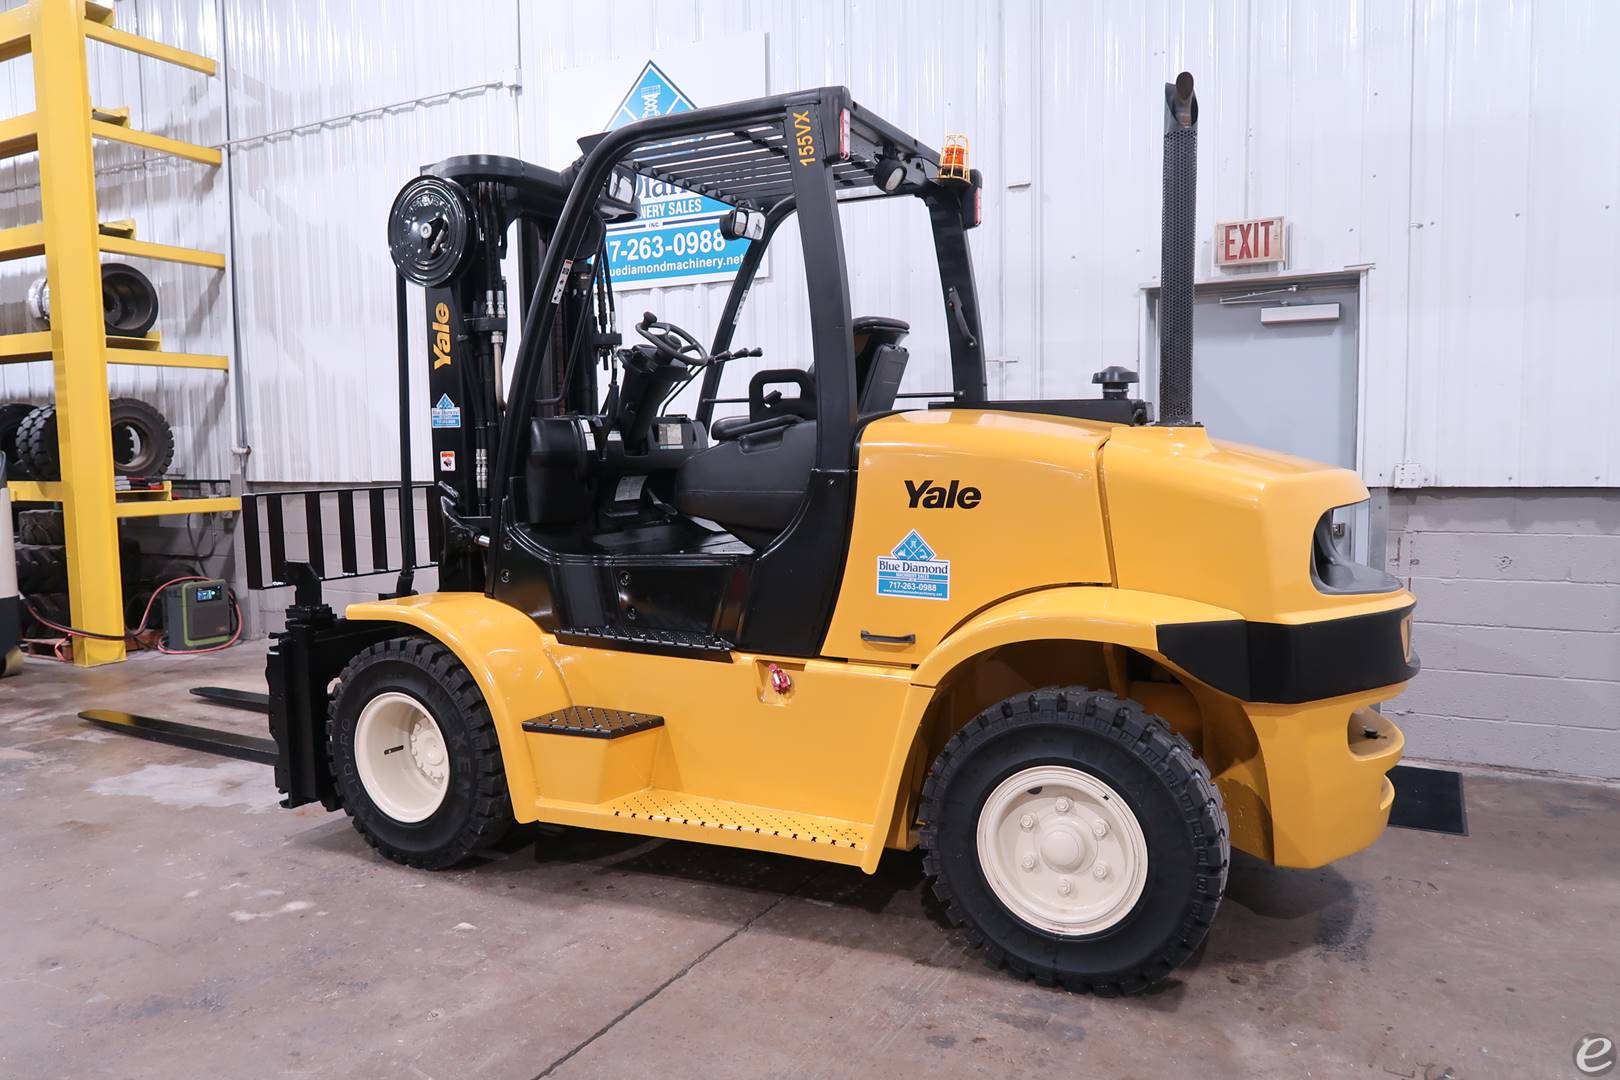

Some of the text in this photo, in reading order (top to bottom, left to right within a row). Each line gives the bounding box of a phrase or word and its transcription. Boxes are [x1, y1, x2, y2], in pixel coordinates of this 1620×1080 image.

[793, 110, 815, 166] 155VX
[640, 198, 702, 219] NERY SALES
[607, 228, 726, 262] 7-263-0988
[1224, 221, 1274, 260] EXIT
[609, 254, 744, 277] uediamondmachinery.net
[432, 303, 451, 370] Yale
[904, 480, 982, 509] Yale
[880, 561, 948, 574] Blue Diamond
[889, 581, 937, 591] 717-263-0988
